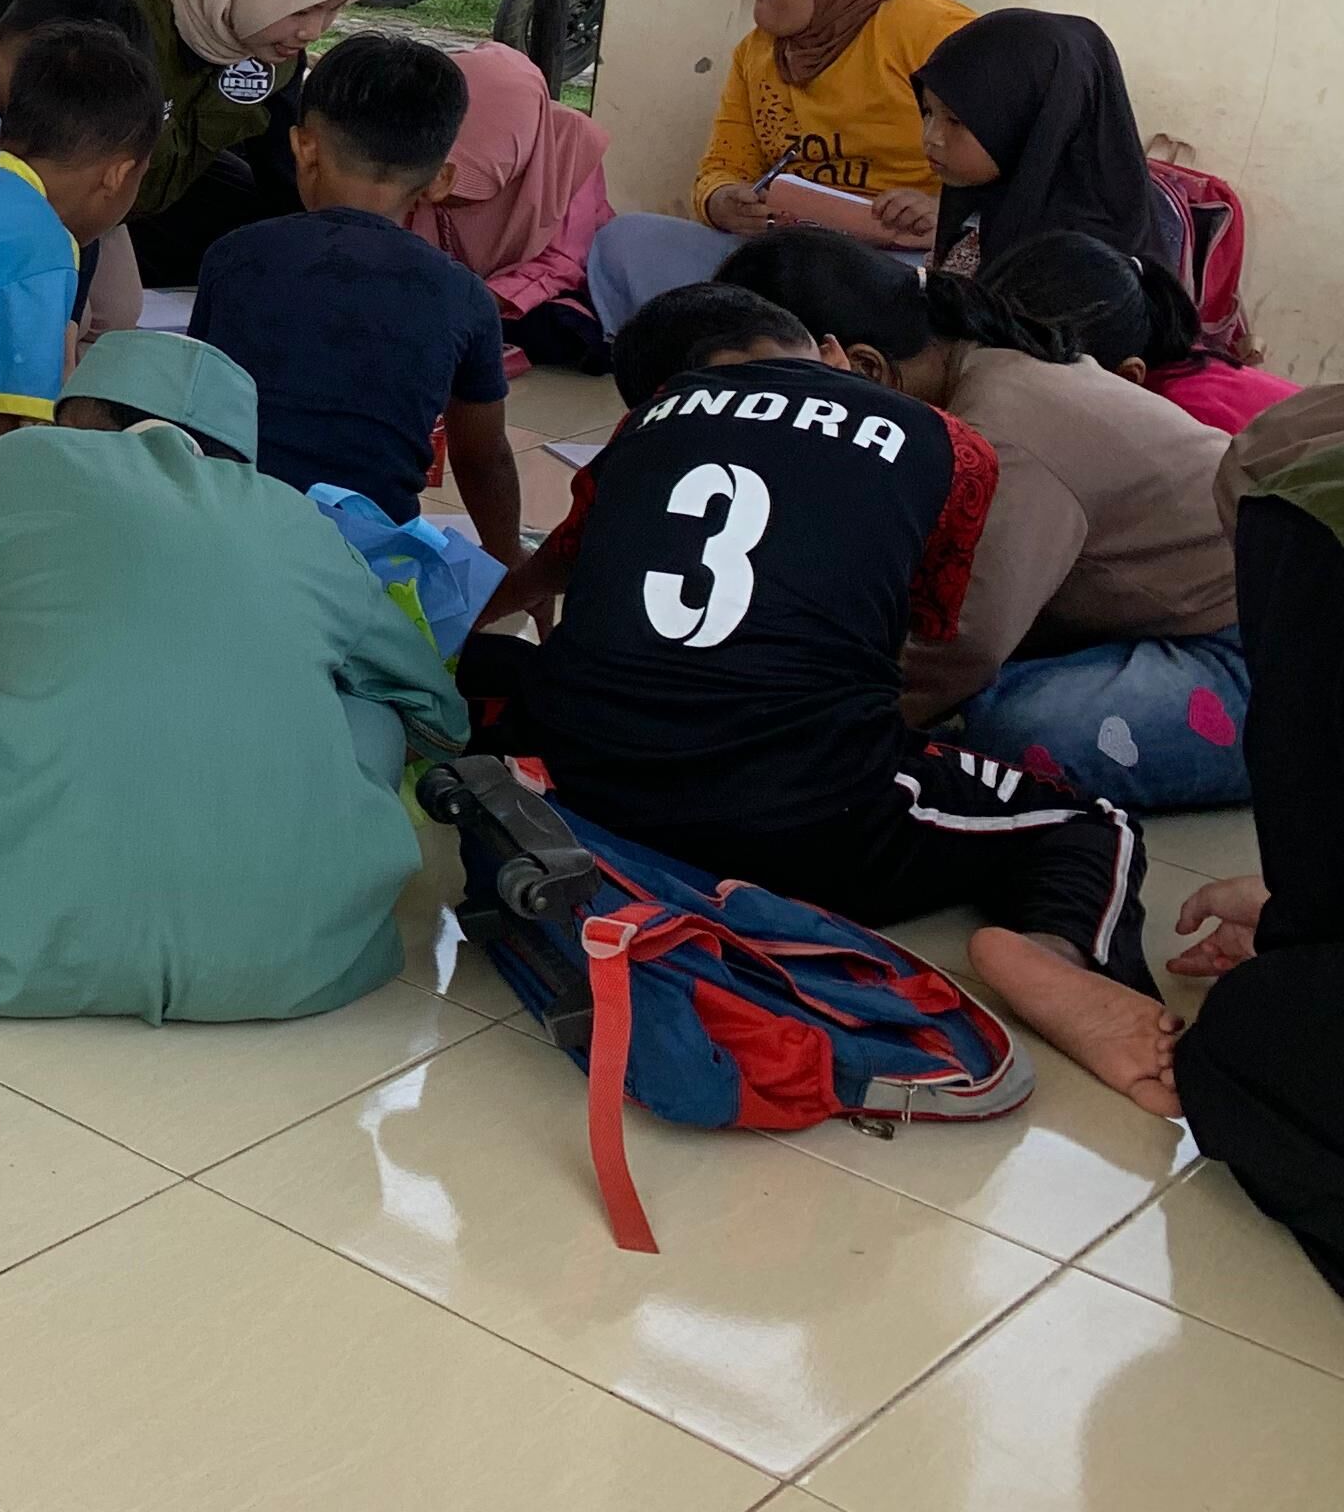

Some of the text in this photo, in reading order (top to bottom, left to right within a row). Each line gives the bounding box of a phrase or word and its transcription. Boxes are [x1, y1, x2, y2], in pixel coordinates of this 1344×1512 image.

[223, 78, 268, 88] IAIN
[637, 389, 906, 464] ANDRA
[643, 463, 771, 648] 3
